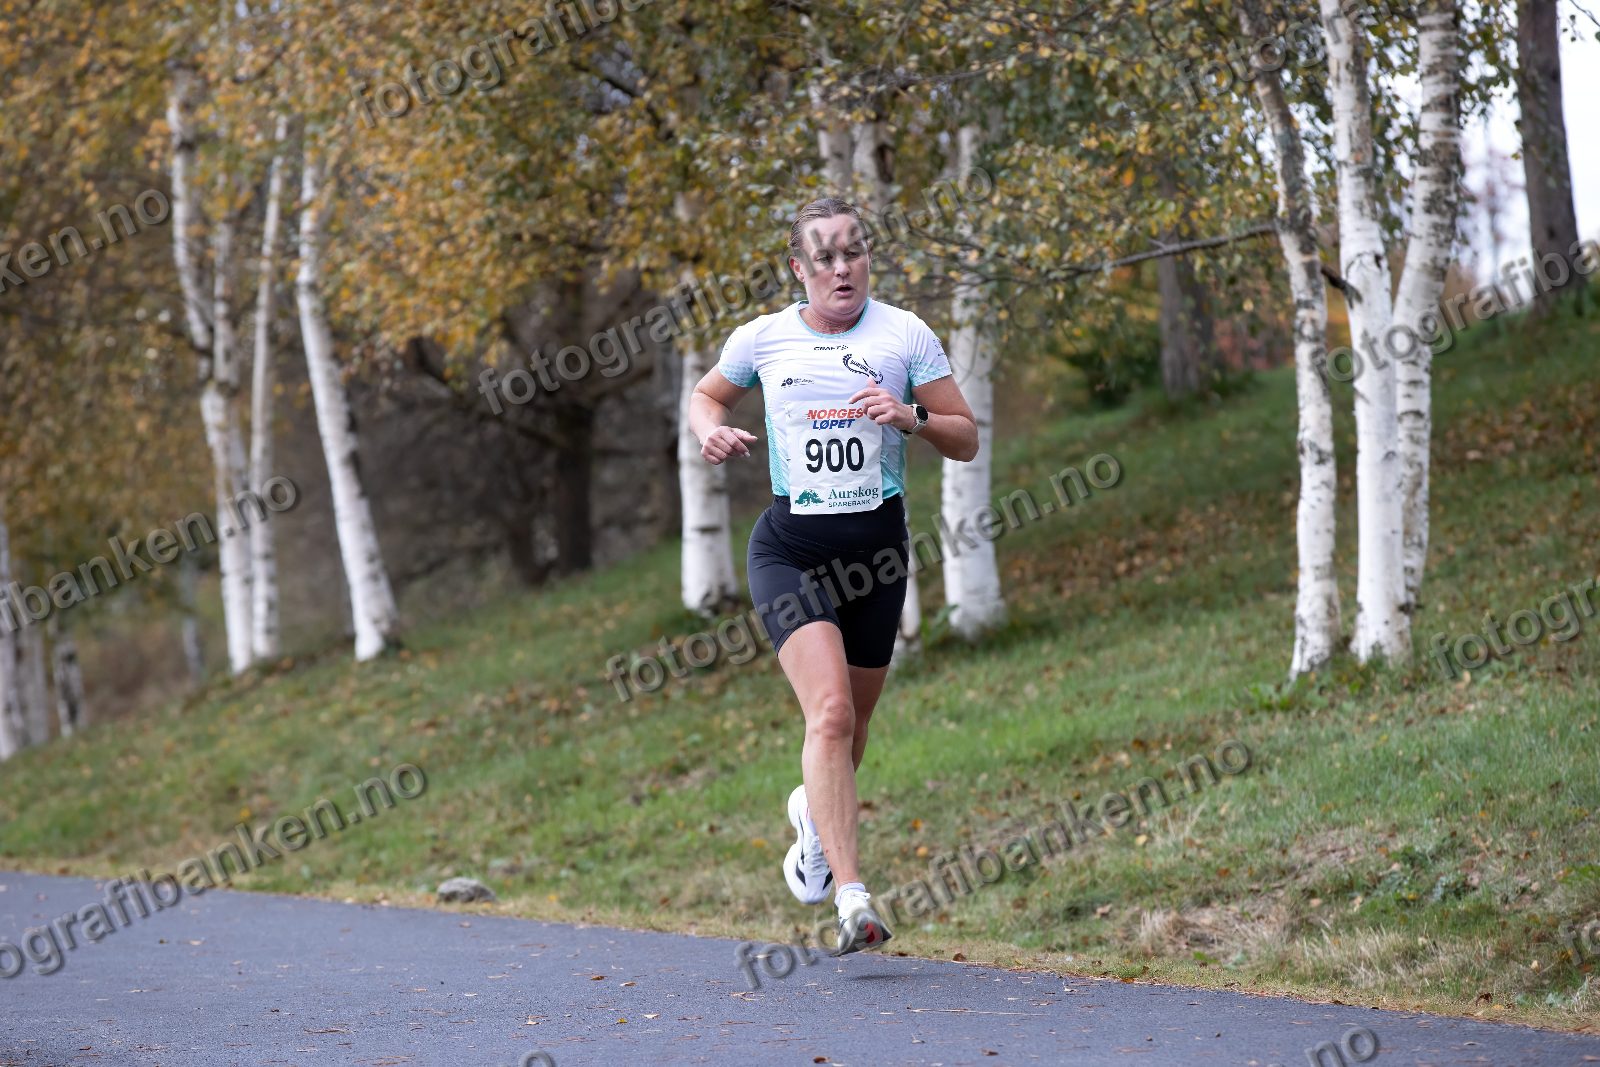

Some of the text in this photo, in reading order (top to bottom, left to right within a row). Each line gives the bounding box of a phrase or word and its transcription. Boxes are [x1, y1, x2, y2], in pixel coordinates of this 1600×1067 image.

[807, 407, 864, 419] NORGES
[813, 419, 855, 430] LØPET
[806, 437, 864, 473] 900
[828, 486, 879, 499] Aurskog
[828, 499, 871, 508] SPAREBANK
